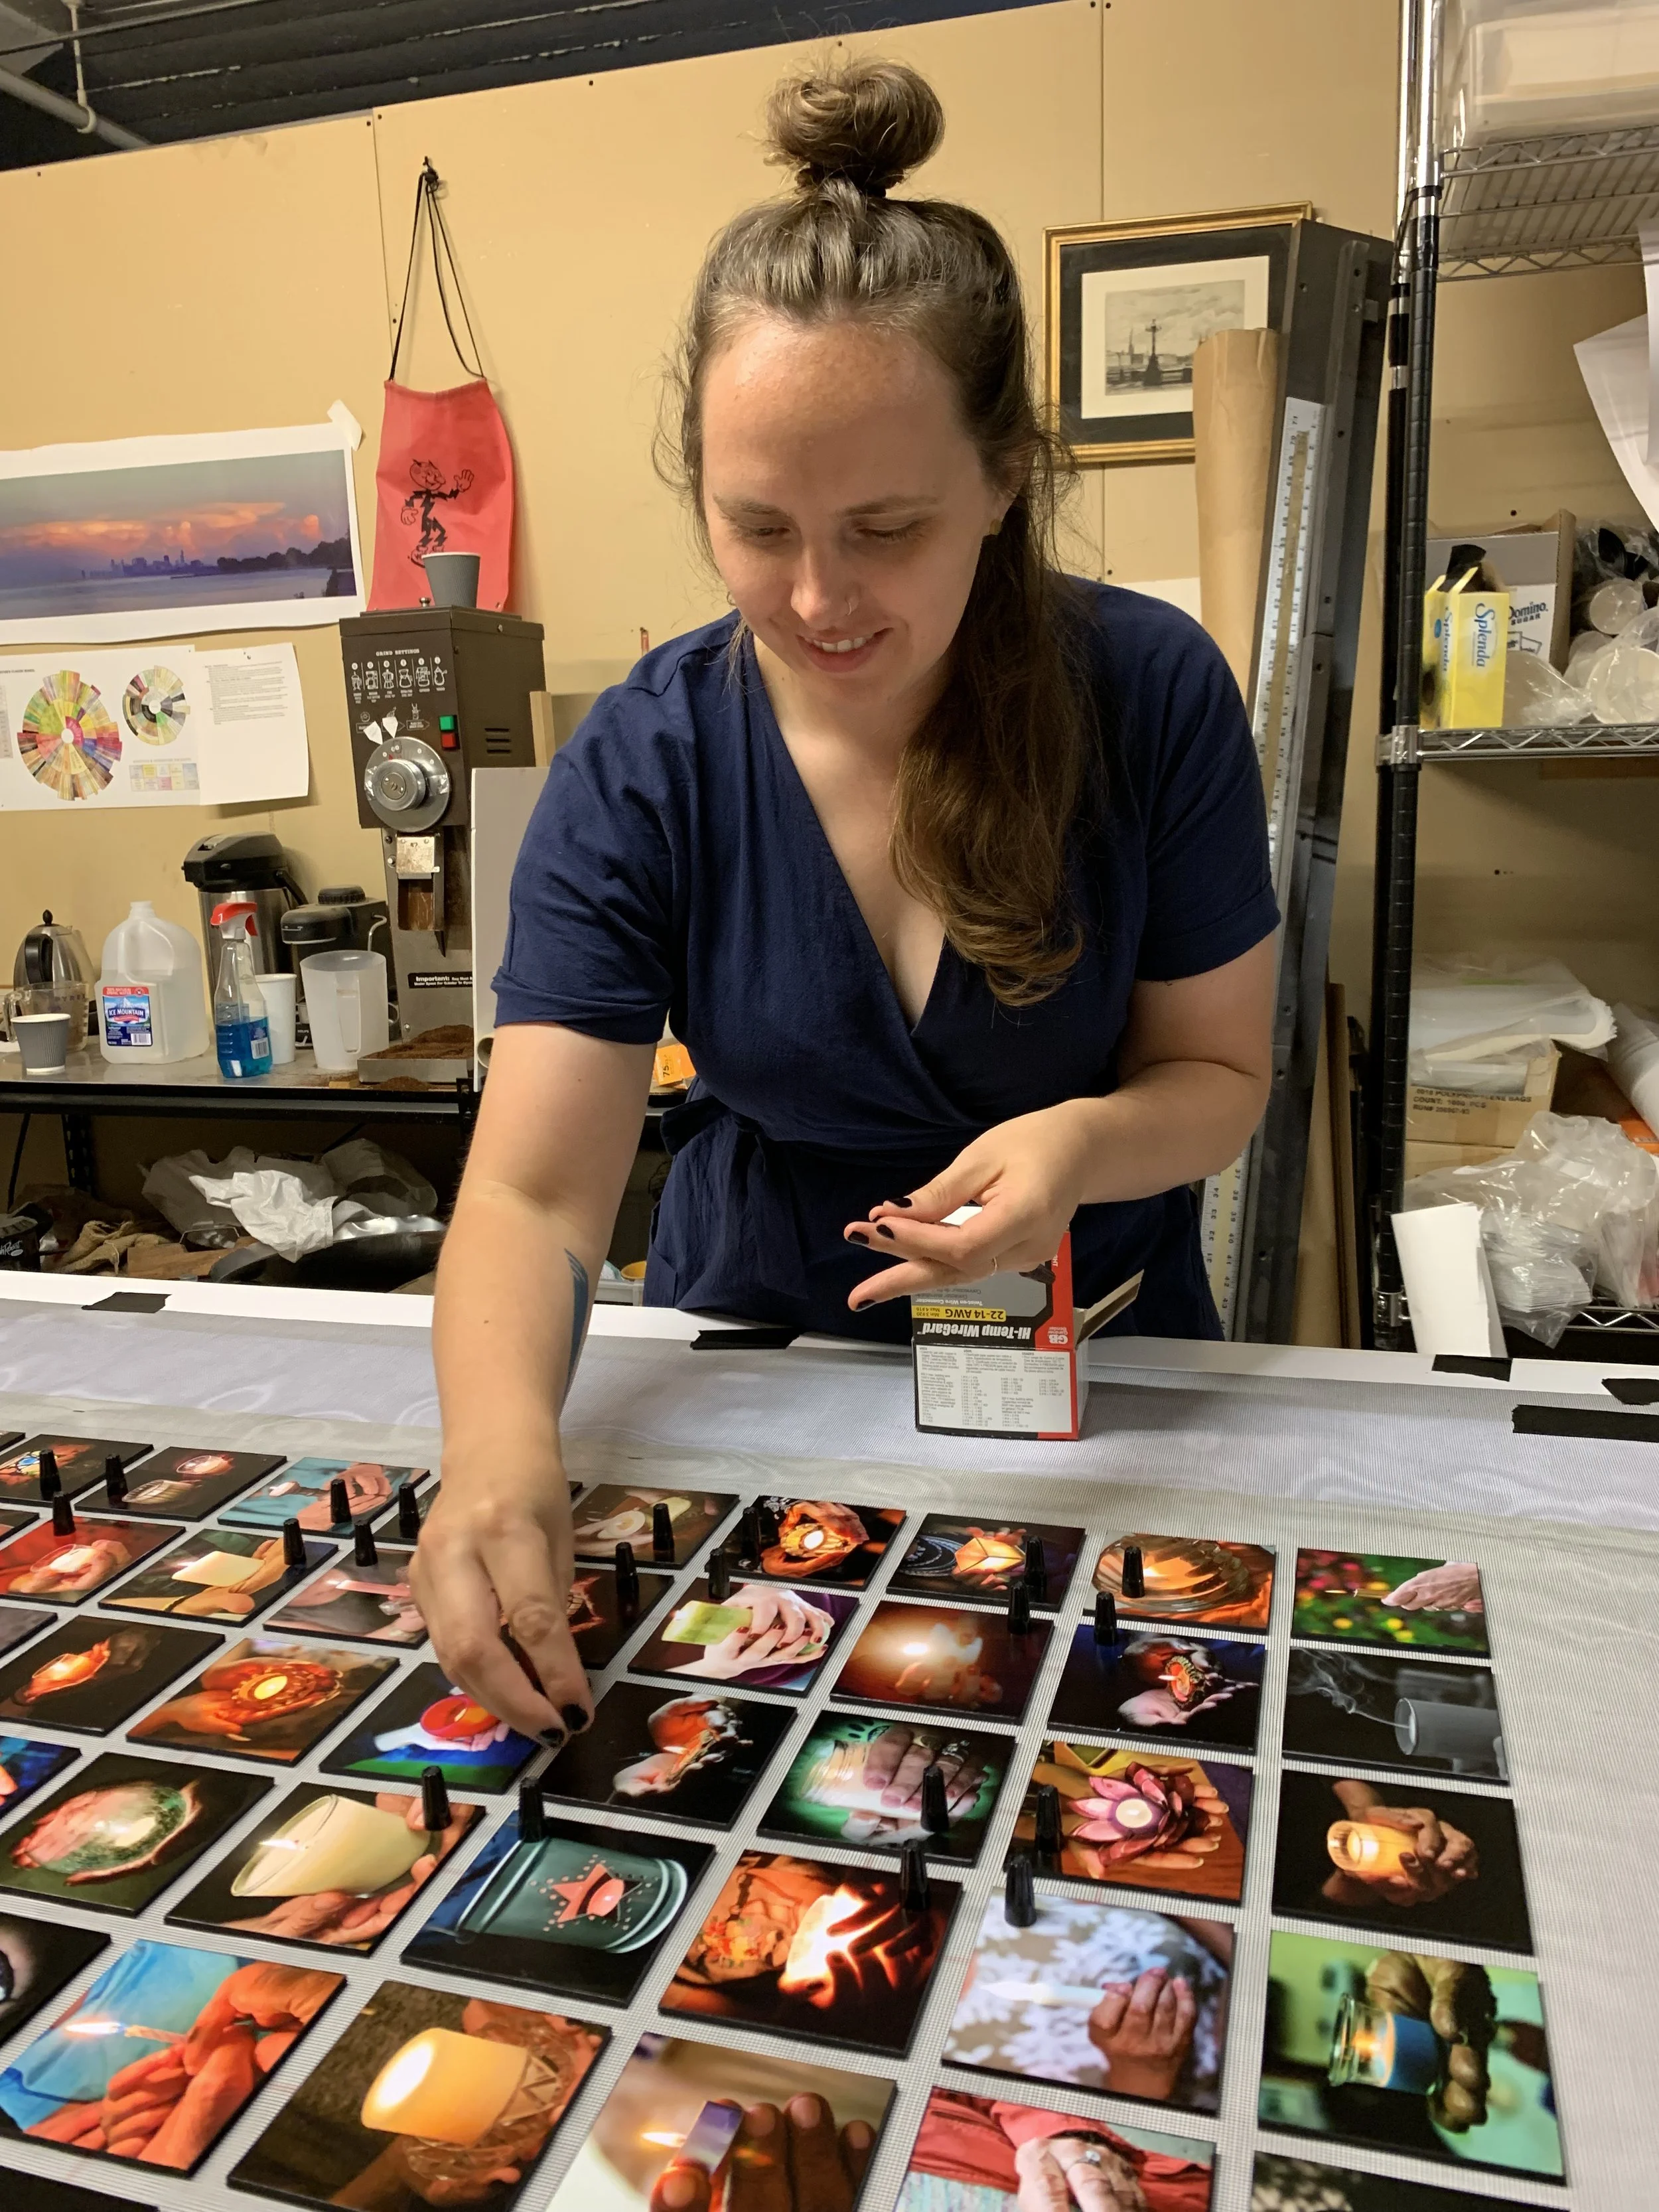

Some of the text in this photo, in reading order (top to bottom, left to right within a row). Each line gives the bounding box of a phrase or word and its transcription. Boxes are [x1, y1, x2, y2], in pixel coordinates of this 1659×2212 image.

[1474, 603, 1496, 667] Splenda
[1235, 1169, 1240, 1179] 37
[1213, 1187, 1219, 1198] 34
[1232, 1190, 1238, 1201] 38
[1211, 1209, 1217, 1219] 33
[1230, 1211, 1236, 1222] 39
[1209, 1230, 1214, 1241] 32
[1228, 1232, 1234, 1244] 40
[1206, 1252, 1212, 1263] 31
[1226, 1254, 1232, 1264] 41
[1224, 1276, 1230, 1287] 42
[1222, 1298, 1228, 1309] 43
[945, 1308, 1004, 1319] 22-14 AWG
[981, 1324, 1032, 1339] Hi-Temp
[1048, 1334, 1068, 1345] GB
